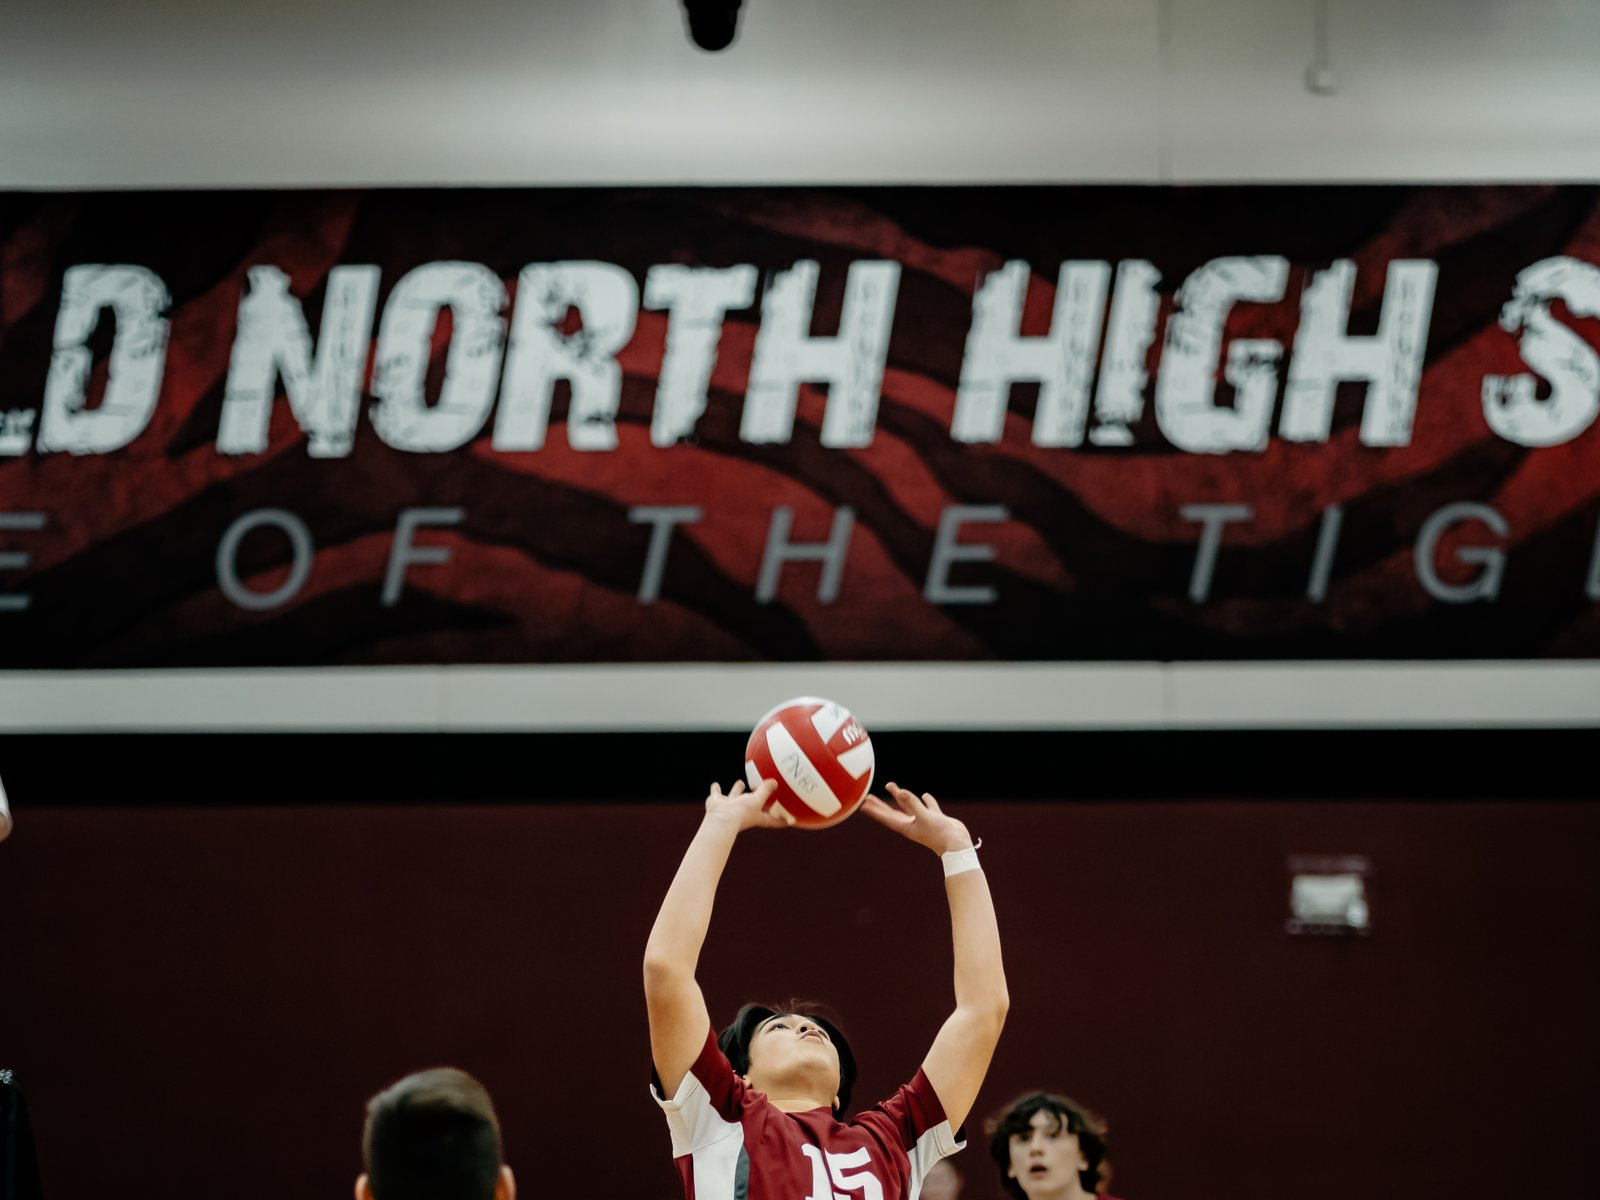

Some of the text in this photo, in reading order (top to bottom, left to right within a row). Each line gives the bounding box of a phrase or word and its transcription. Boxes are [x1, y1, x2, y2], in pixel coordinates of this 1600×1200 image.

[216, 260, 901, 458] NORTH
[950, 255, 1440, 454] HIGH
[1481, 255, 1600, 447] S
[216, 508, 467, 611] OF
[627, 504, 1010, 605] THE
[1180, 502, 1600, 603] TIG
